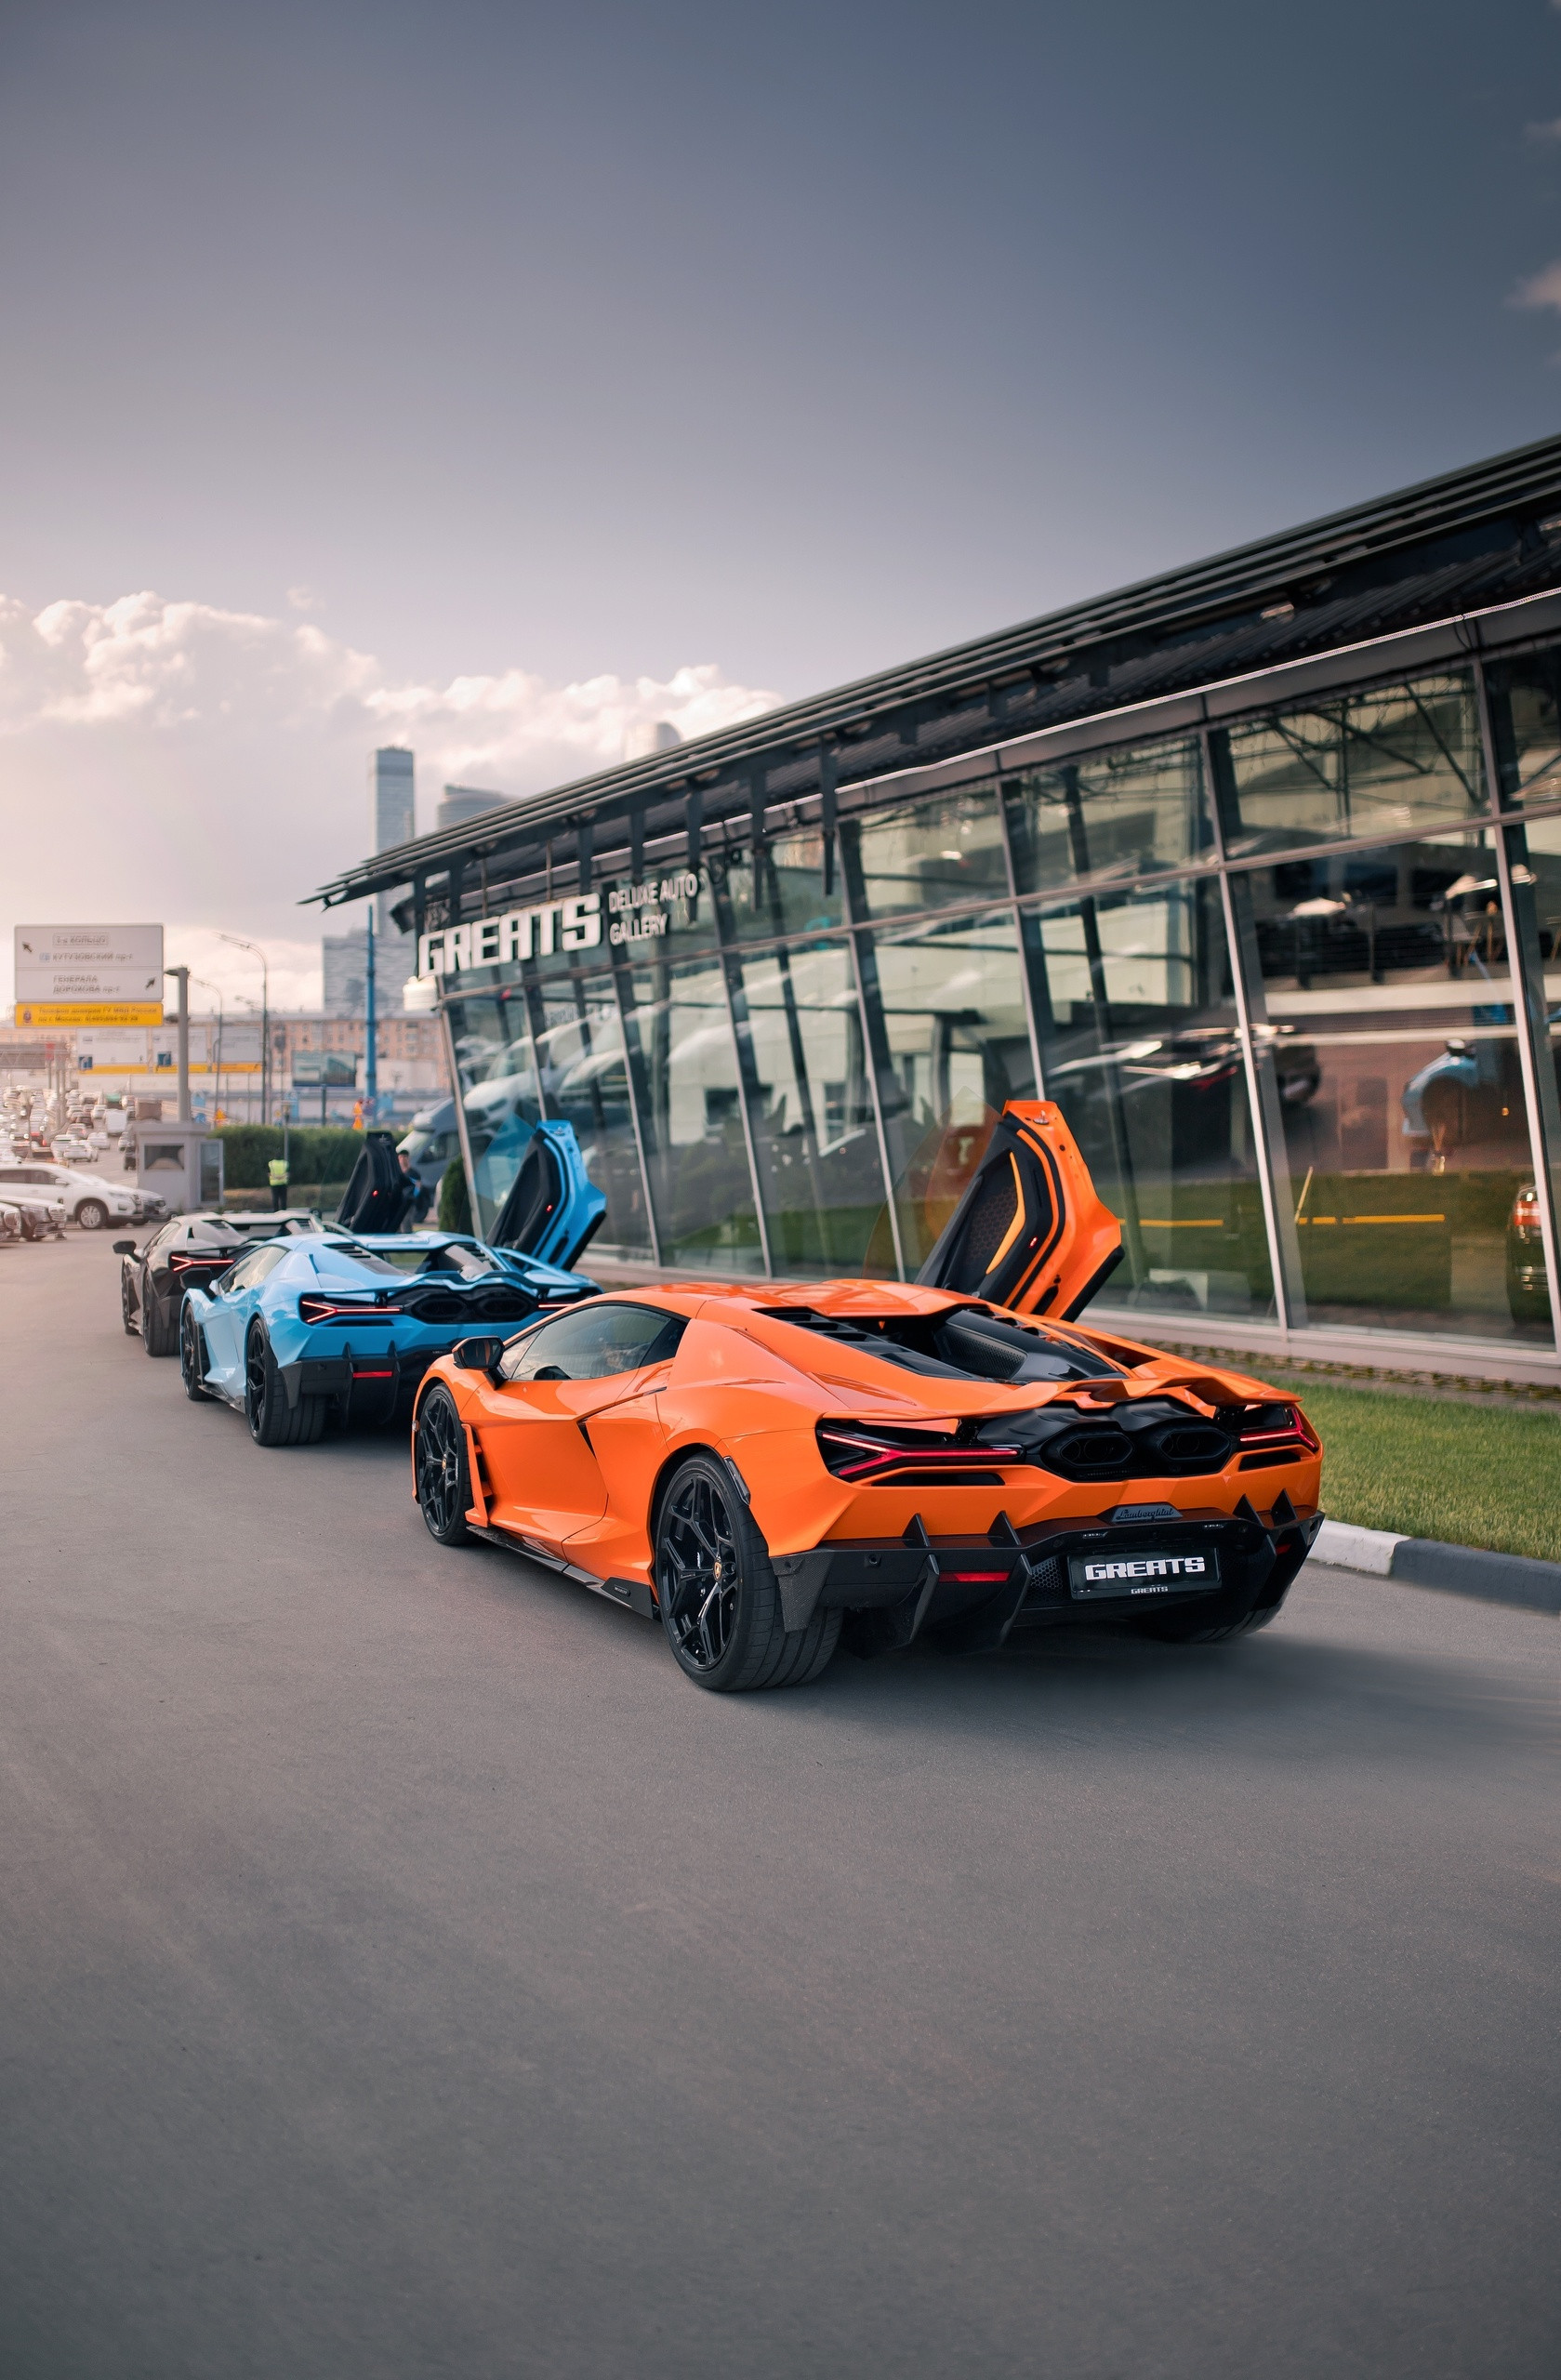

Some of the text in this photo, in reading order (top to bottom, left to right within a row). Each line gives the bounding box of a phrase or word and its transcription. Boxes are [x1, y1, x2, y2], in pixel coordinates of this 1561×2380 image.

[609, 873, 698, 914] DELUXE AUTO
[418, 893, 601, 981] GREATS
[610, 912, 668, 945] GALLERY
[1085, 1556, 1206, 1580] GREATS
[1131, 1586, 1169, 1594] GREATS
